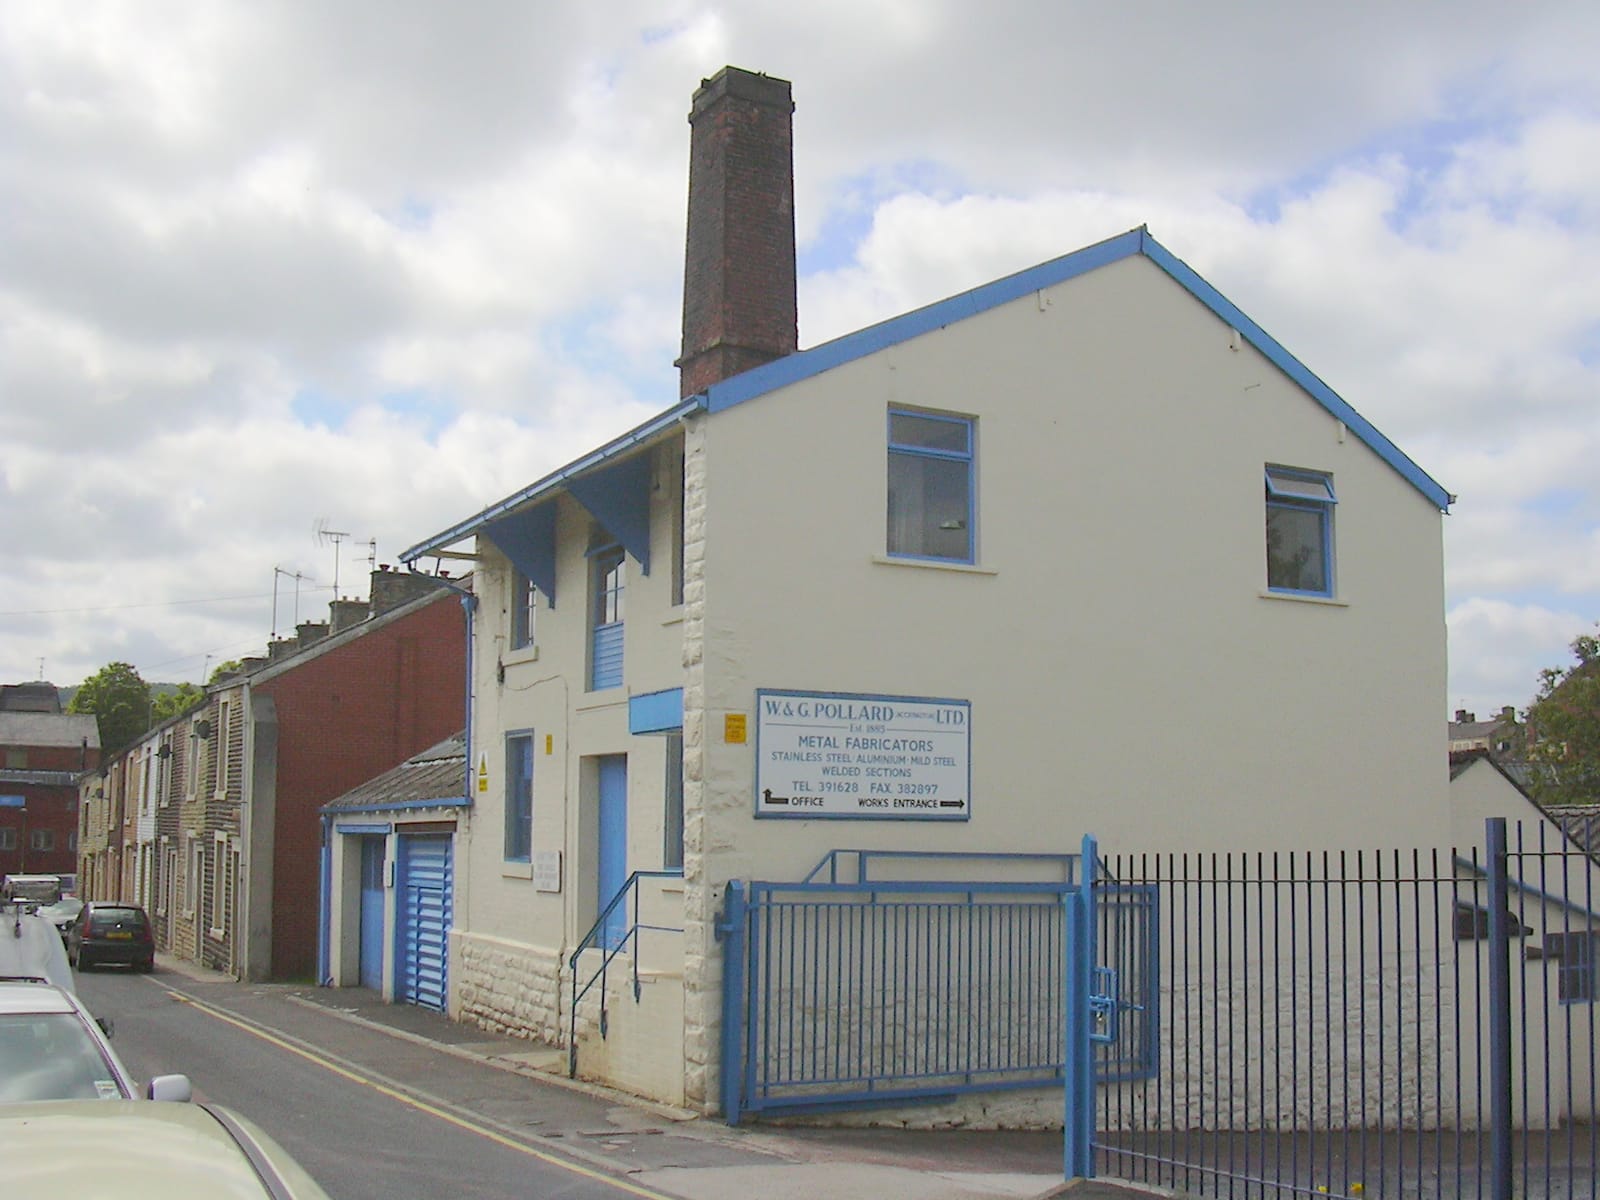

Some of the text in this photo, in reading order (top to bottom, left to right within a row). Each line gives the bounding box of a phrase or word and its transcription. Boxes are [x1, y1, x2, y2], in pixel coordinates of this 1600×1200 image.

[783, 702, 794, 717] &
[815, 703, 894, 721] POLLARD
[798, 736, 934, 753] METAL FABRICATORS
[771, 751, 957, 767] STAINLESS STEEL ALUMINIUM MILD STEEL
[821, 766, 912, 778] WELDED SECTIONS
[792, 781, 938, 795] TEL 391628 FAX 382897
[791, 796, 824, 807] OFFICE
[858, 798, 939, 809] WORKS ENTRANCE
